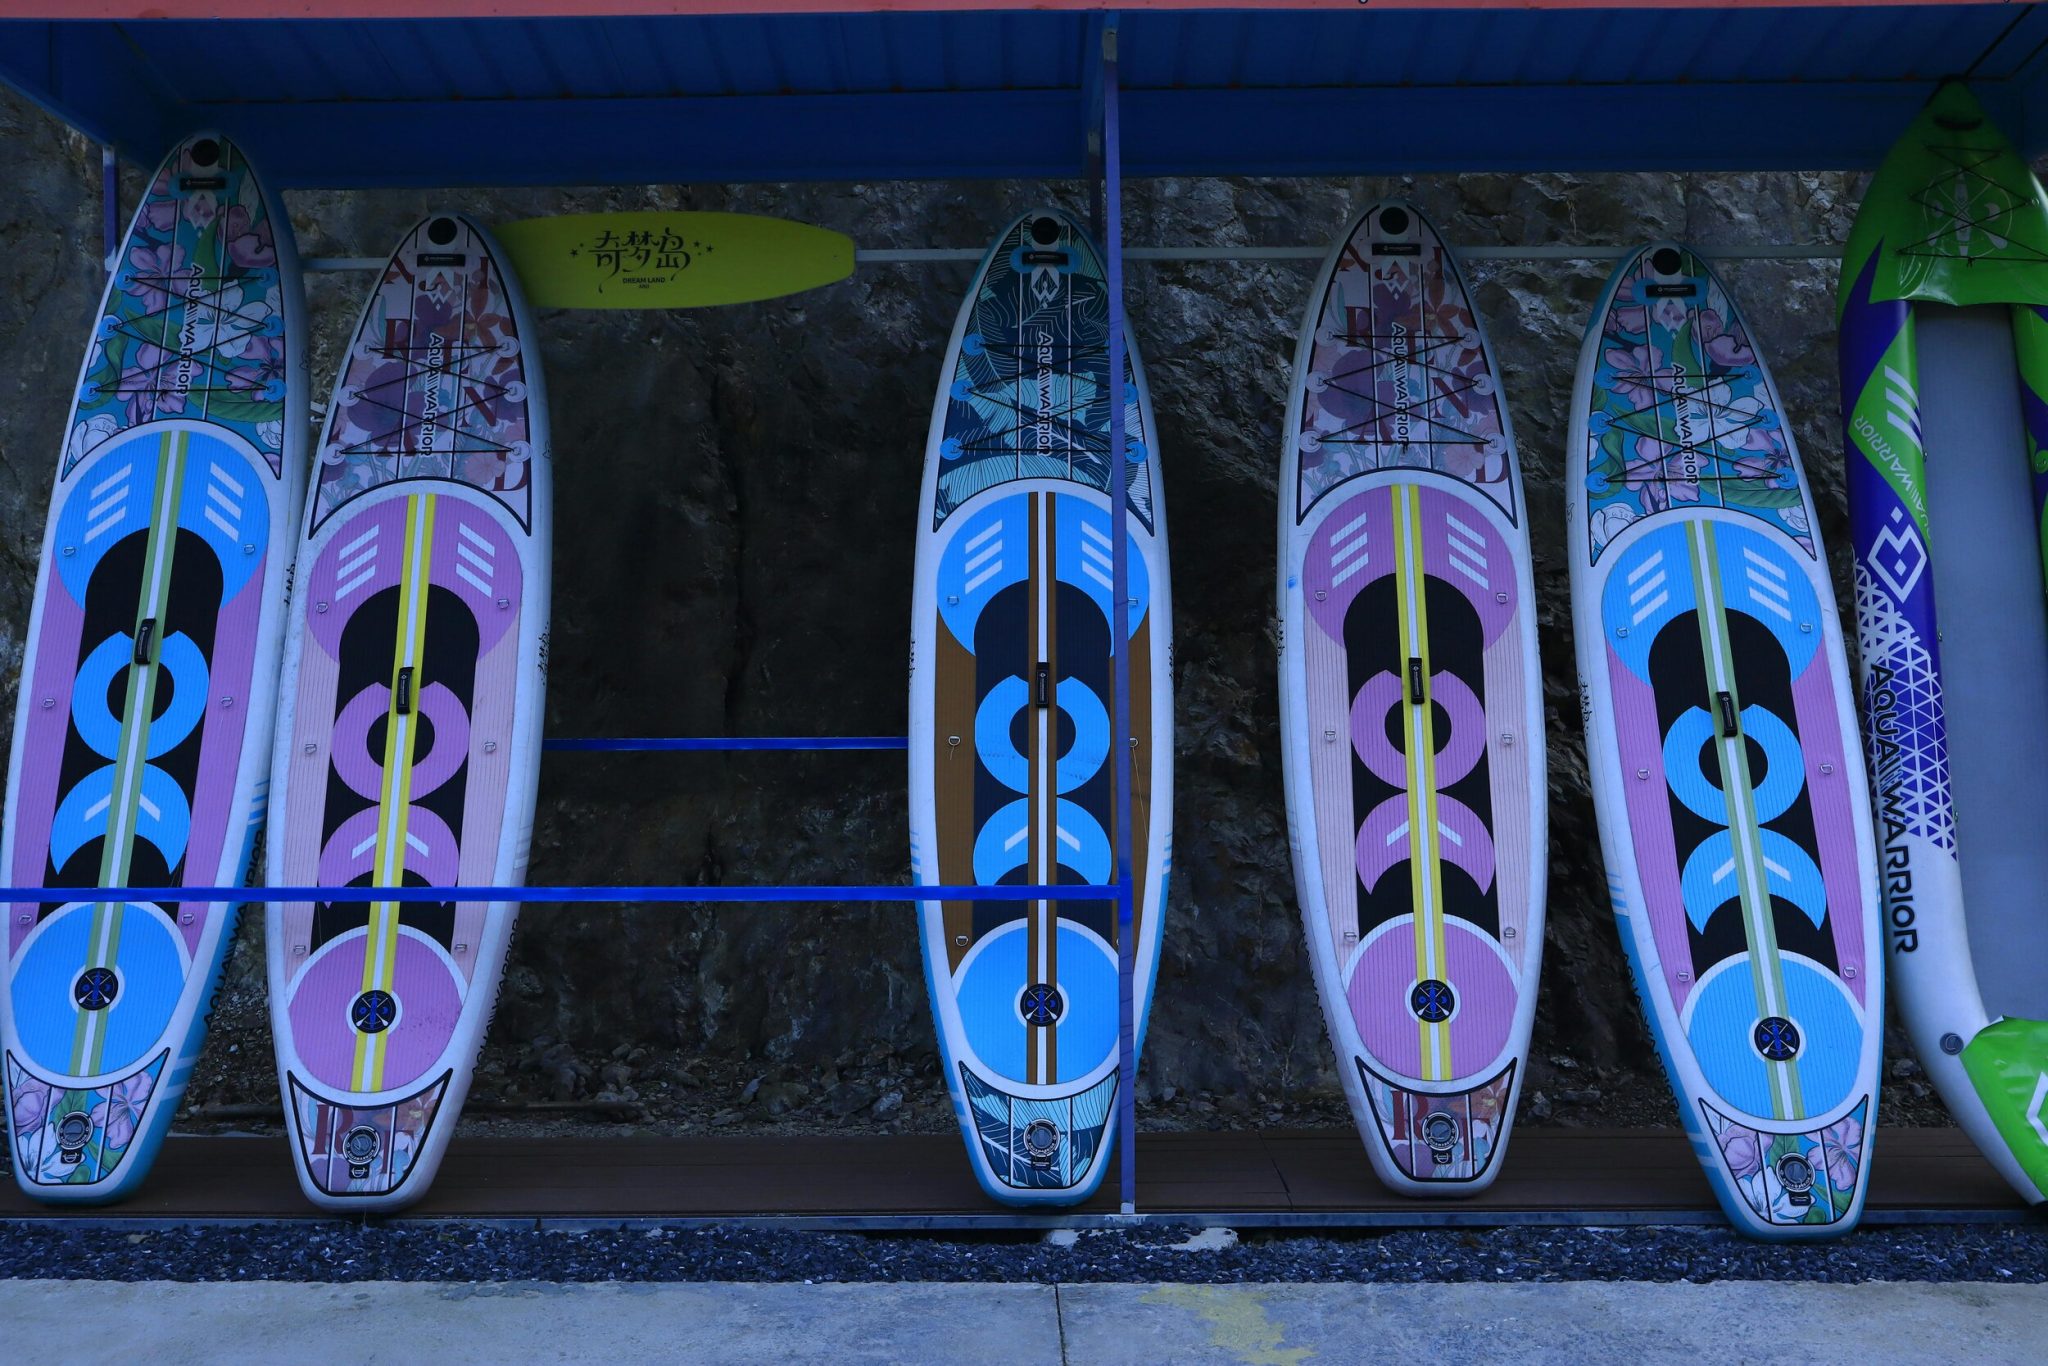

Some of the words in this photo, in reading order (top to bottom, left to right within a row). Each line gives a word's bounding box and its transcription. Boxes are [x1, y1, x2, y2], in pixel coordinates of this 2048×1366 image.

[588, 227, 691, 293] 奇梦岛
[228, 829, 263, 942] WARIOR
